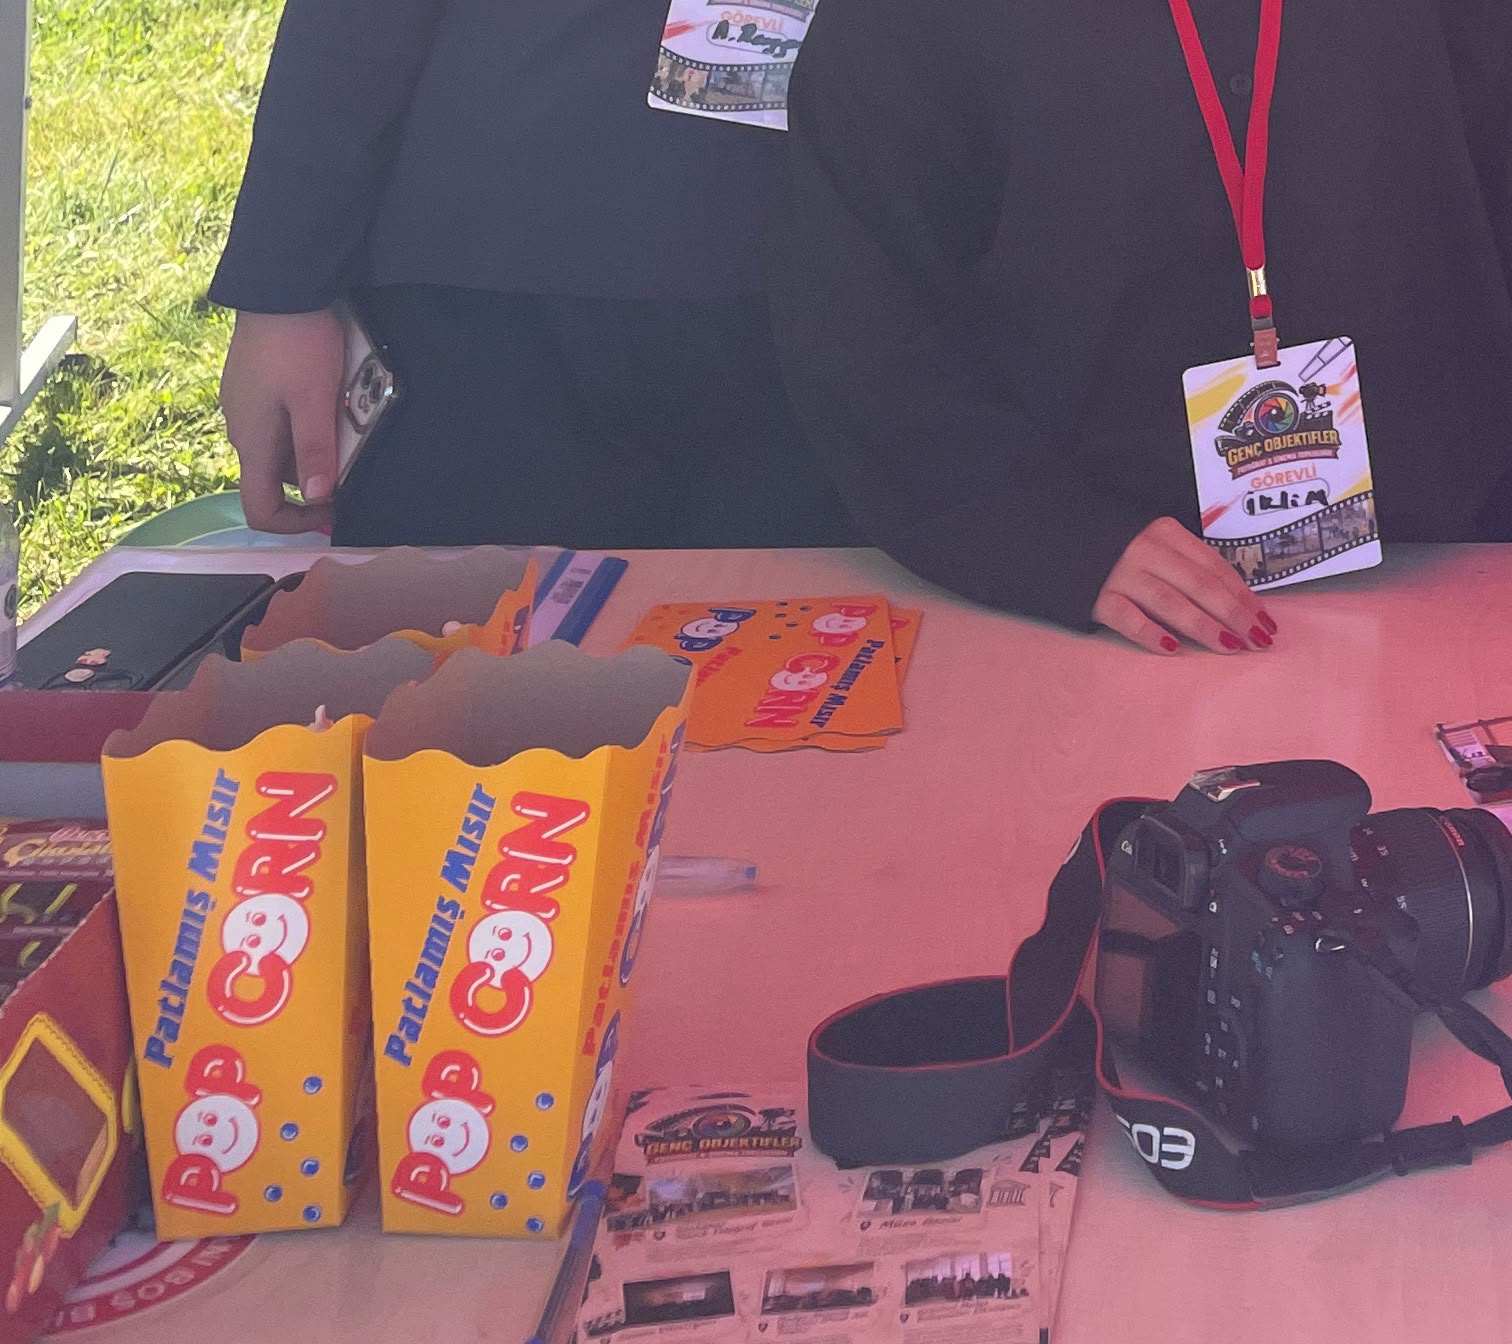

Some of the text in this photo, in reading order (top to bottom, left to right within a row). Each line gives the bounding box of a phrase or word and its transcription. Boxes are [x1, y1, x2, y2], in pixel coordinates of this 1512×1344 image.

[1228, 442, 1263, 466] GENÇ
[1250, 463, 1317, 489] GÖREVLİ
[143, 768, 241, 1069] Patlamış Mısır
[206, 770, 338, 1028] CORN
[383, 782, 497, 1068] Patlamış Mısır
[449, 790, 591, 1038] CORN
